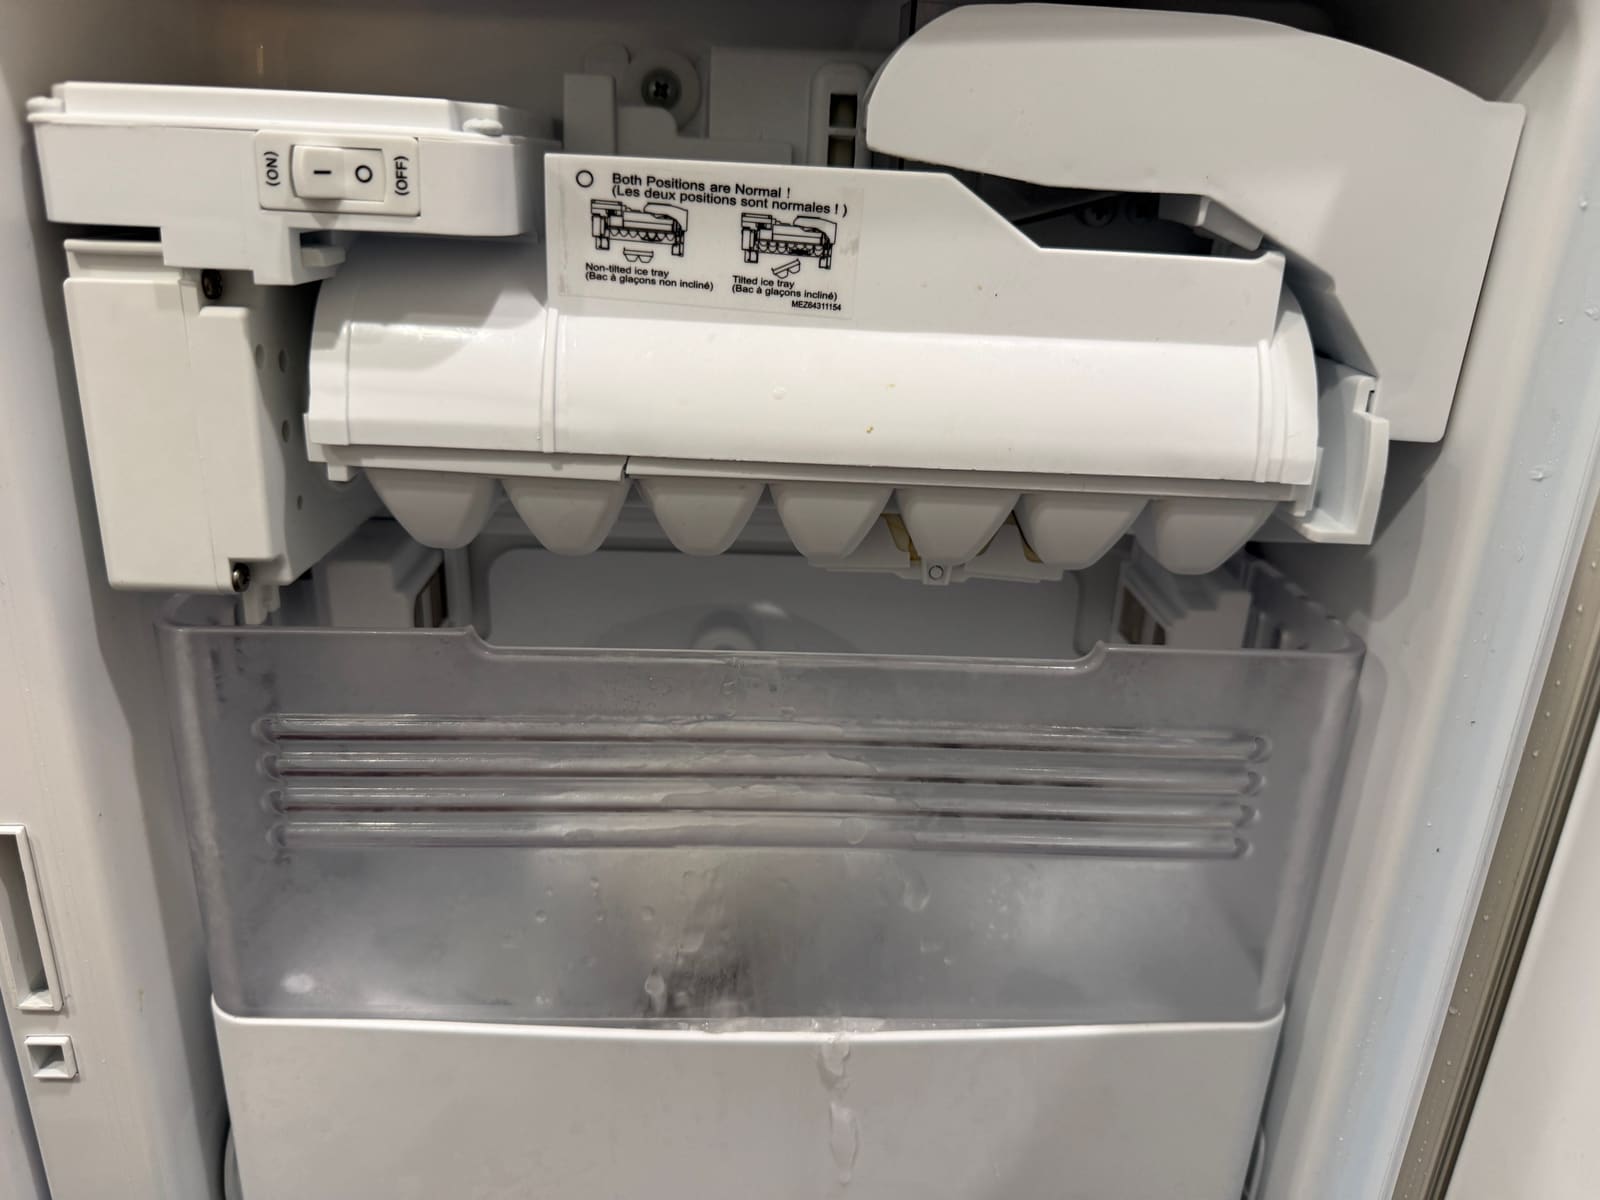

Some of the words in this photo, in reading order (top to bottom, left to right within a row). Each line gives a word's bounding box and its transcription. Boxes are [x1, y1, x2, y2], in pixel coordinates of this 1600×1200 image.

[263, 151, 281, 187] (ON)
[393, 155, 410, 196] (OFF)
[612, 173, 642, 187] Both
[646, 176, 705, 191] Positions
[709, 183, 731, 194] are
[735, 183, 782, 198] Normal
[611, 184, 640, 198] (Les
[644, 187, 676, 201] deux
[680, 191, 735, 207] positions
[740, 195, 768, 209] sont
[772, 199, 831, 214] normales
[585, 262, 632, 275] Non-tilted
[634, 267, 649, 276] ice
[651, 269, 670, 280] tray
[585, 271, 608, 281] (Bac
[610, 272, 616, 281] à
[619, 275, 657, 286] glaçons
[659, 279, 677, 287] non
[680, 280, 714, 292] incliné)
[732, 275, 758, 285] Tilted
[760, 278, 774, 287] ice
[777, 279, 795, 290] tray
[732, 284, 754, 294] (Bac
[756, 286, 762, 294] à
[765, 288, 801, 298] glaçons
[804, 290, 838, 302] incliné)
